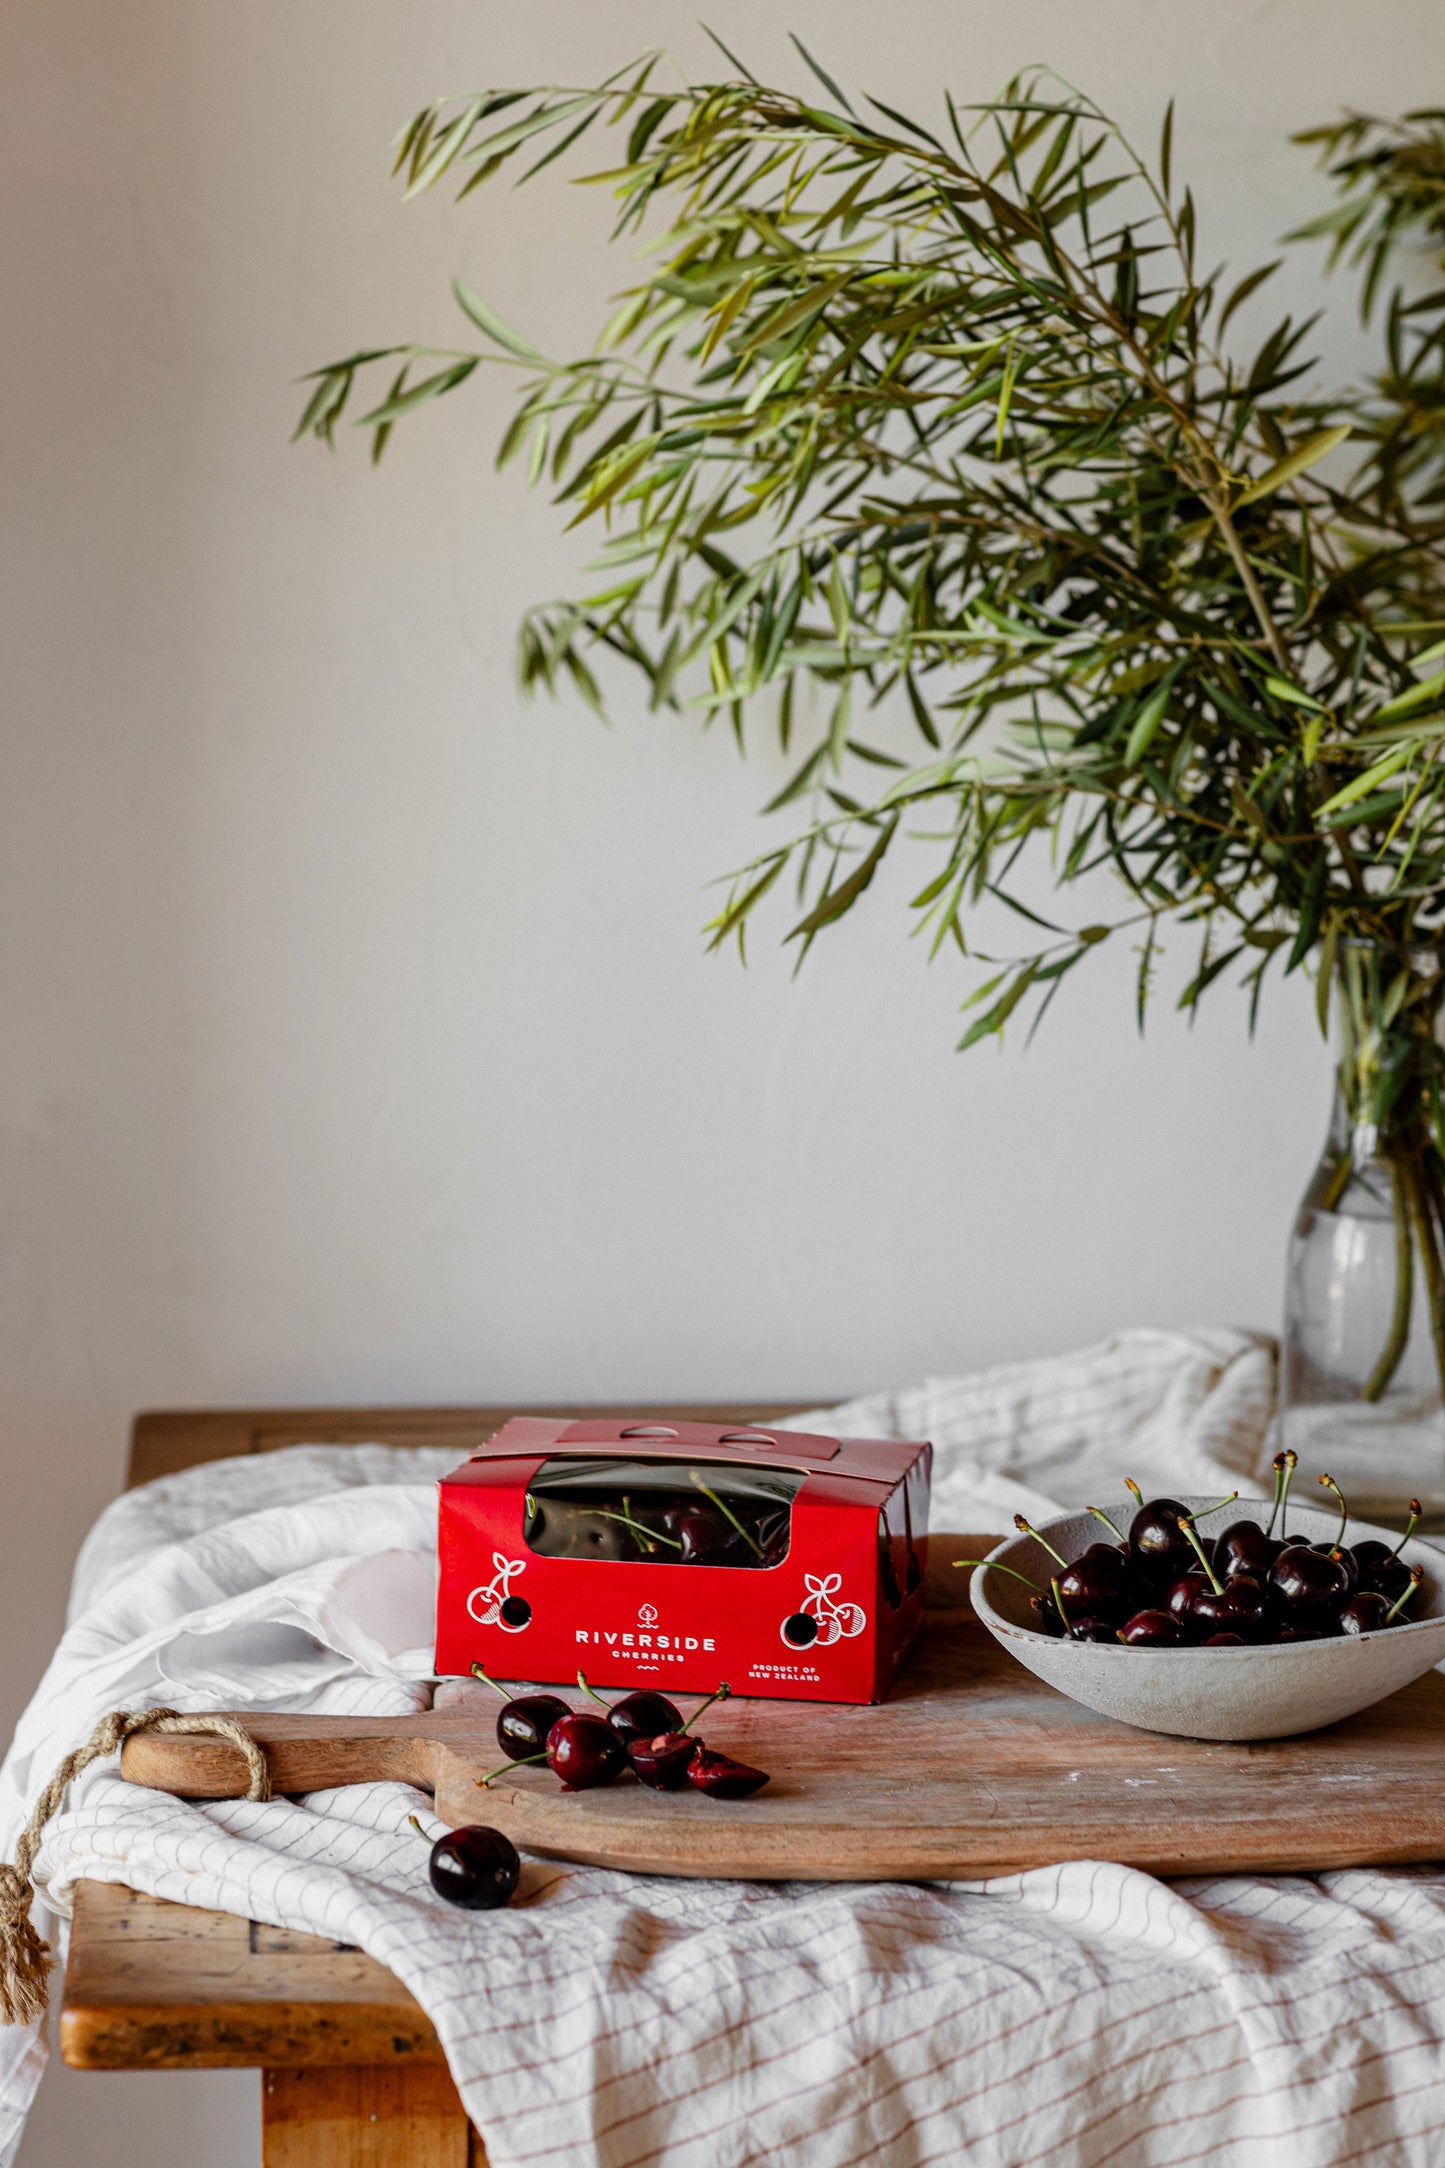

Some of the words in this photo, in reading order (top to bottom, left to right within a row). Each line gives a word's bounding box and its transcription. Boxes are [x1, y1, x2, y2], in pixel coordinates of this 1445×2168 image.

[575, 1630, 716, 1651] RIVERSIDE
[611, 1650, 684, 1662] CHERRIES
[752, 1663, 799, 1673] PRODUCT
[802, 1666, 816, 1674] OF
[748, 1671, 771, 1679] NEW
[774, 1672, 820, 1682] ZEALAND
